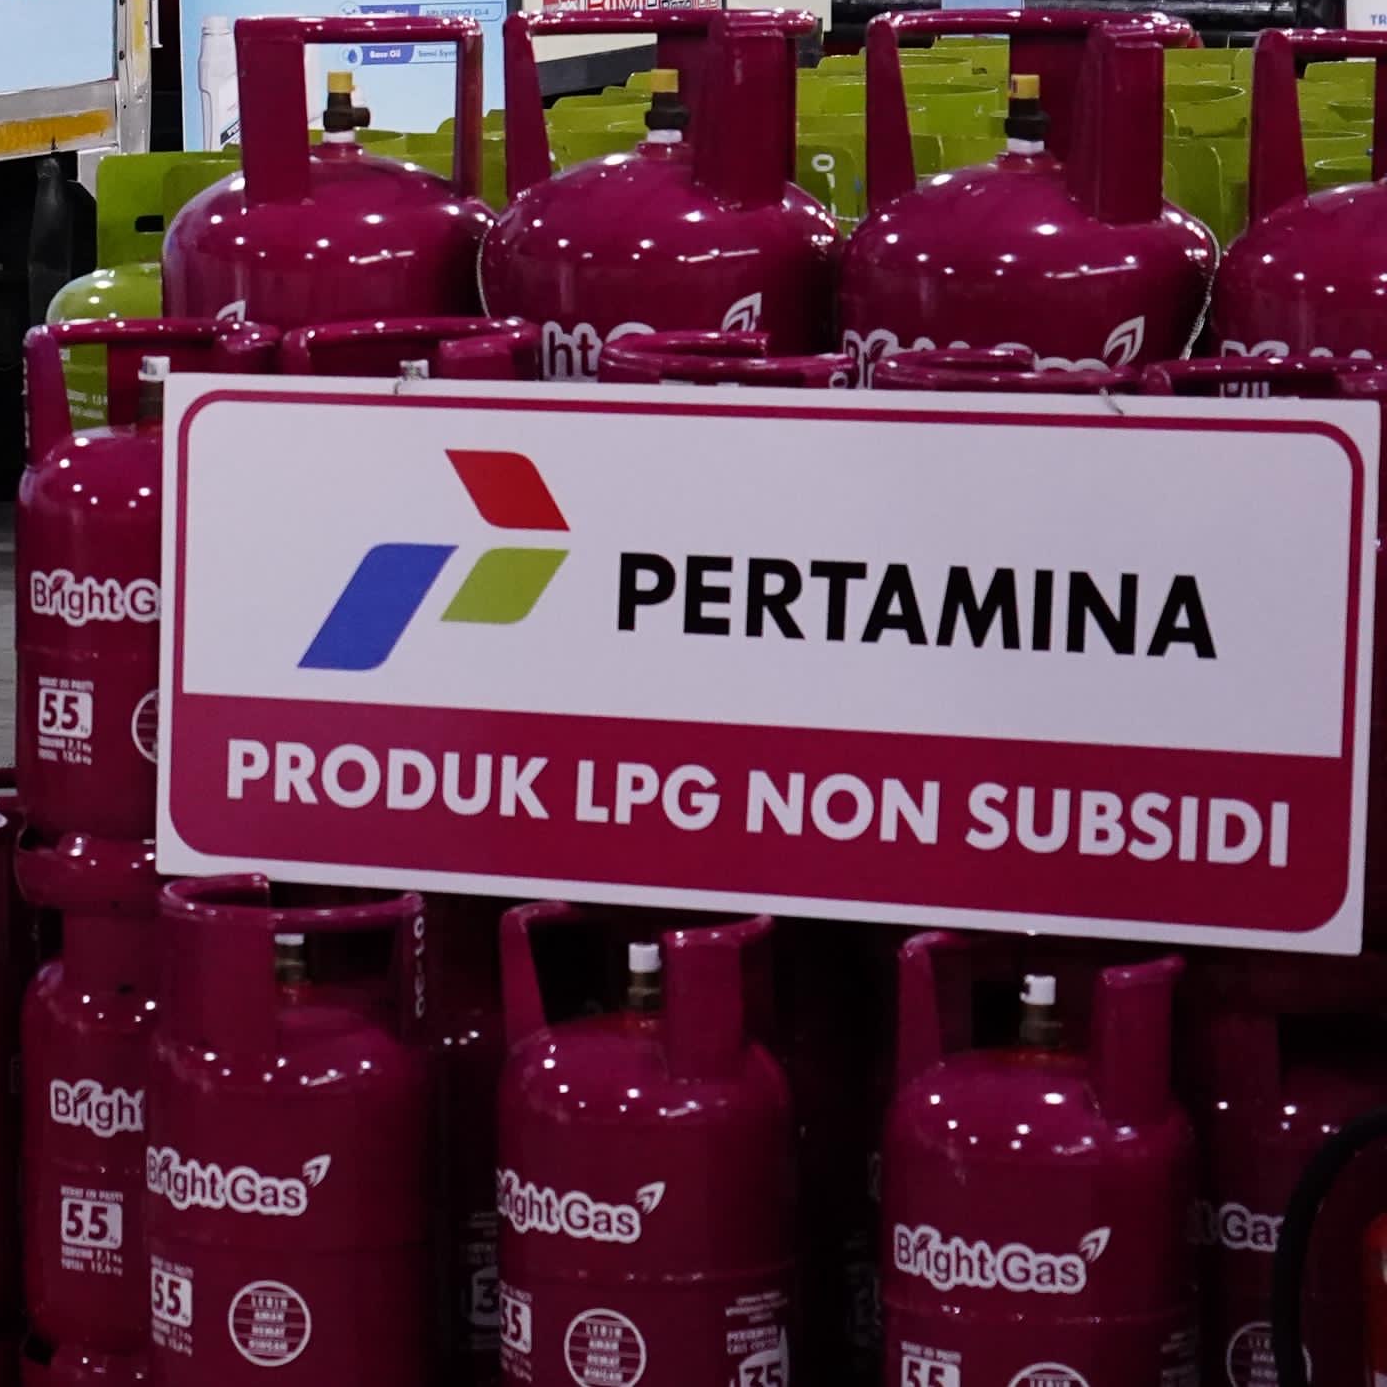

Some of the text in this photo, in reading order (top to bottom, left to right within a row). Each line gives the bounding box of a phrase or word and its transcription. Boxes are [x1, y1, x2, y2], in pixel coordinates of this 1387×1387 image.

[616, 551, 1218, 659] PERTAMINA
[226, 737, 1290, 868] PRODUK LPG NON SUBSIDI
[1219, 1201, 1285, 1253] Ga
